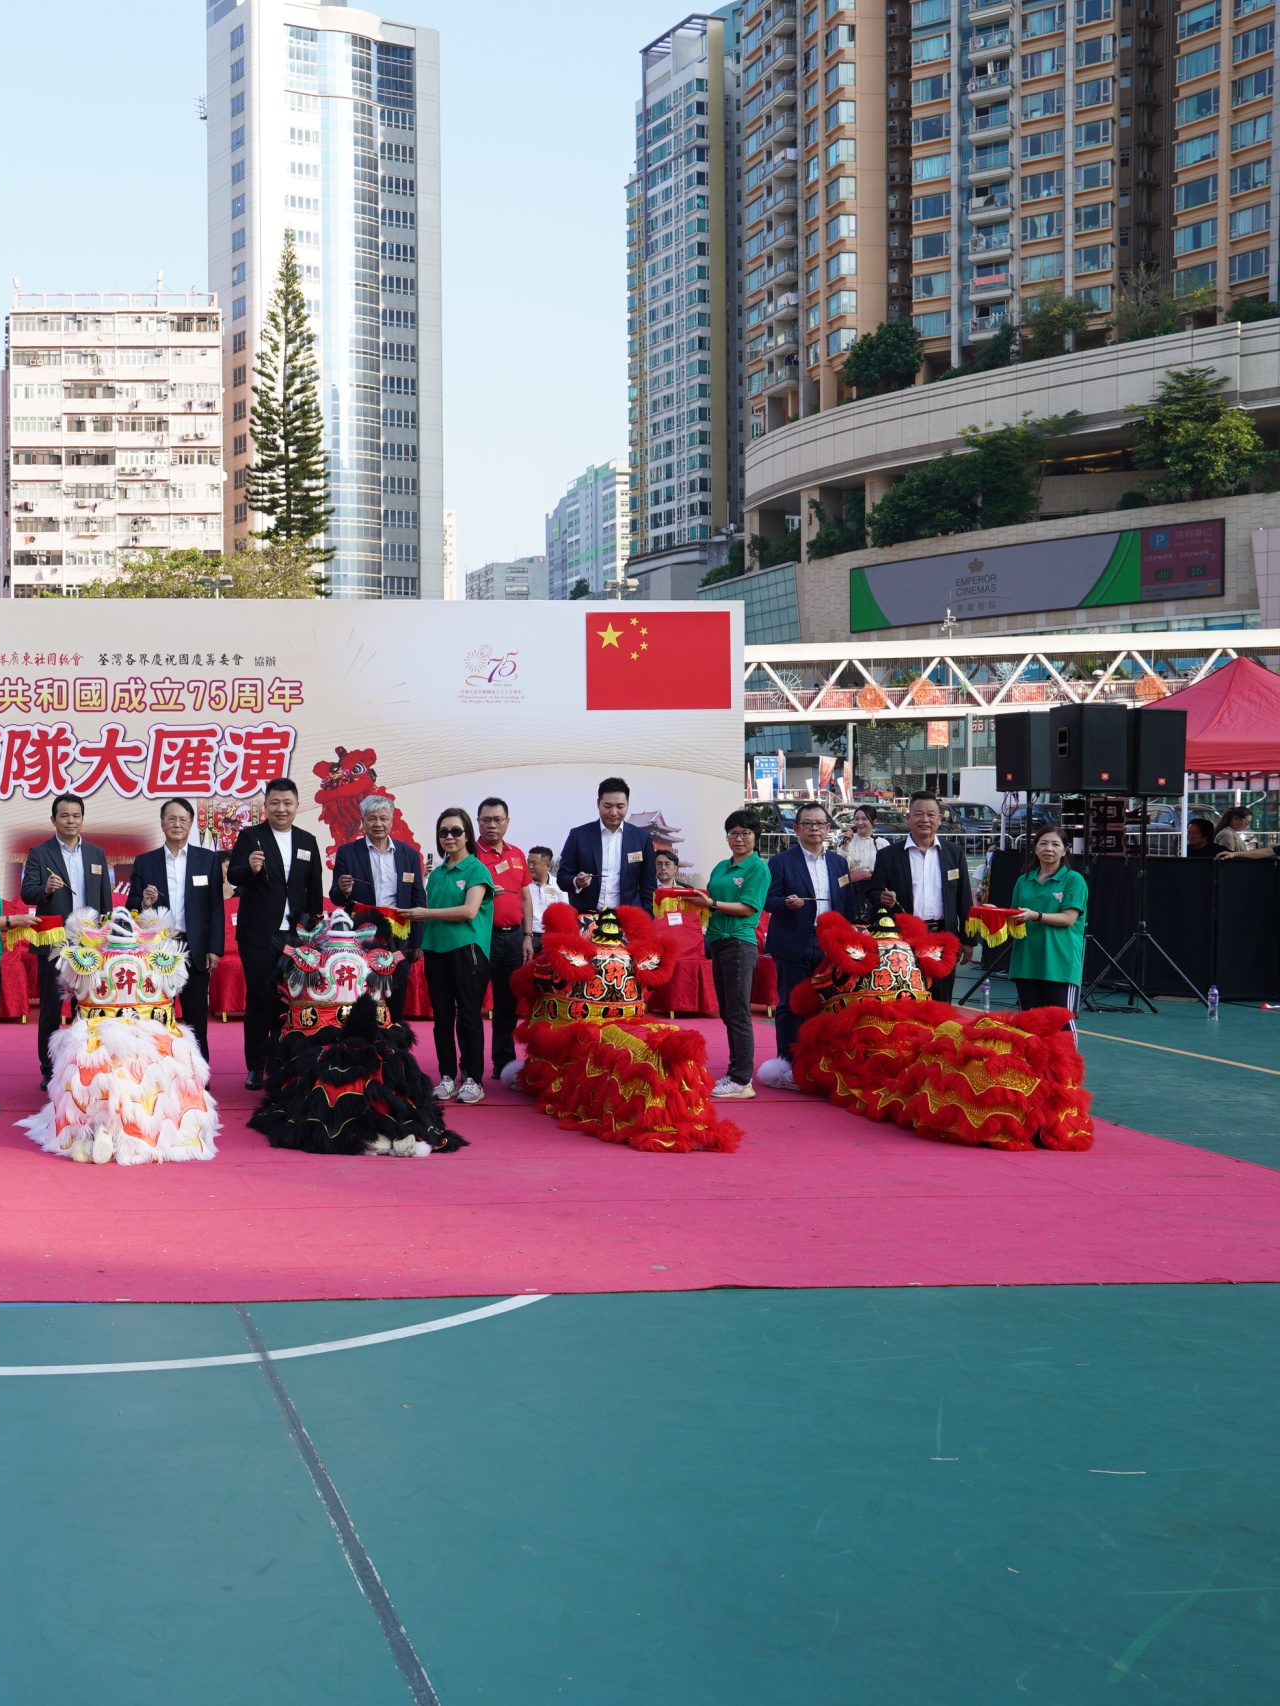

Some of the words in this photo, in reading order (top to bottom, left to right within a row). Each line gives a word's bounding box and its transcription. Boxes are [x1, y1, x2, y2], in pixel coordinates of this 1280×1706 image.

[1156, 535, 1164, 546] P
[1144, 553, 1173, 562] citywalk
[1180, 549, 1210, 558] citywalk
[956, 574, 996, 586] EMPEROR
[956, 584, 996, 596] CINEMAS
[98, 653, 244, 666] 荃灣各界慶祝國慶籌委會
[254, 656, 276, 667] 協辦
[487, 650, 518, 683] 75
[116, 968, 137, 994] 許
[336, 964, 358, 991] 許
